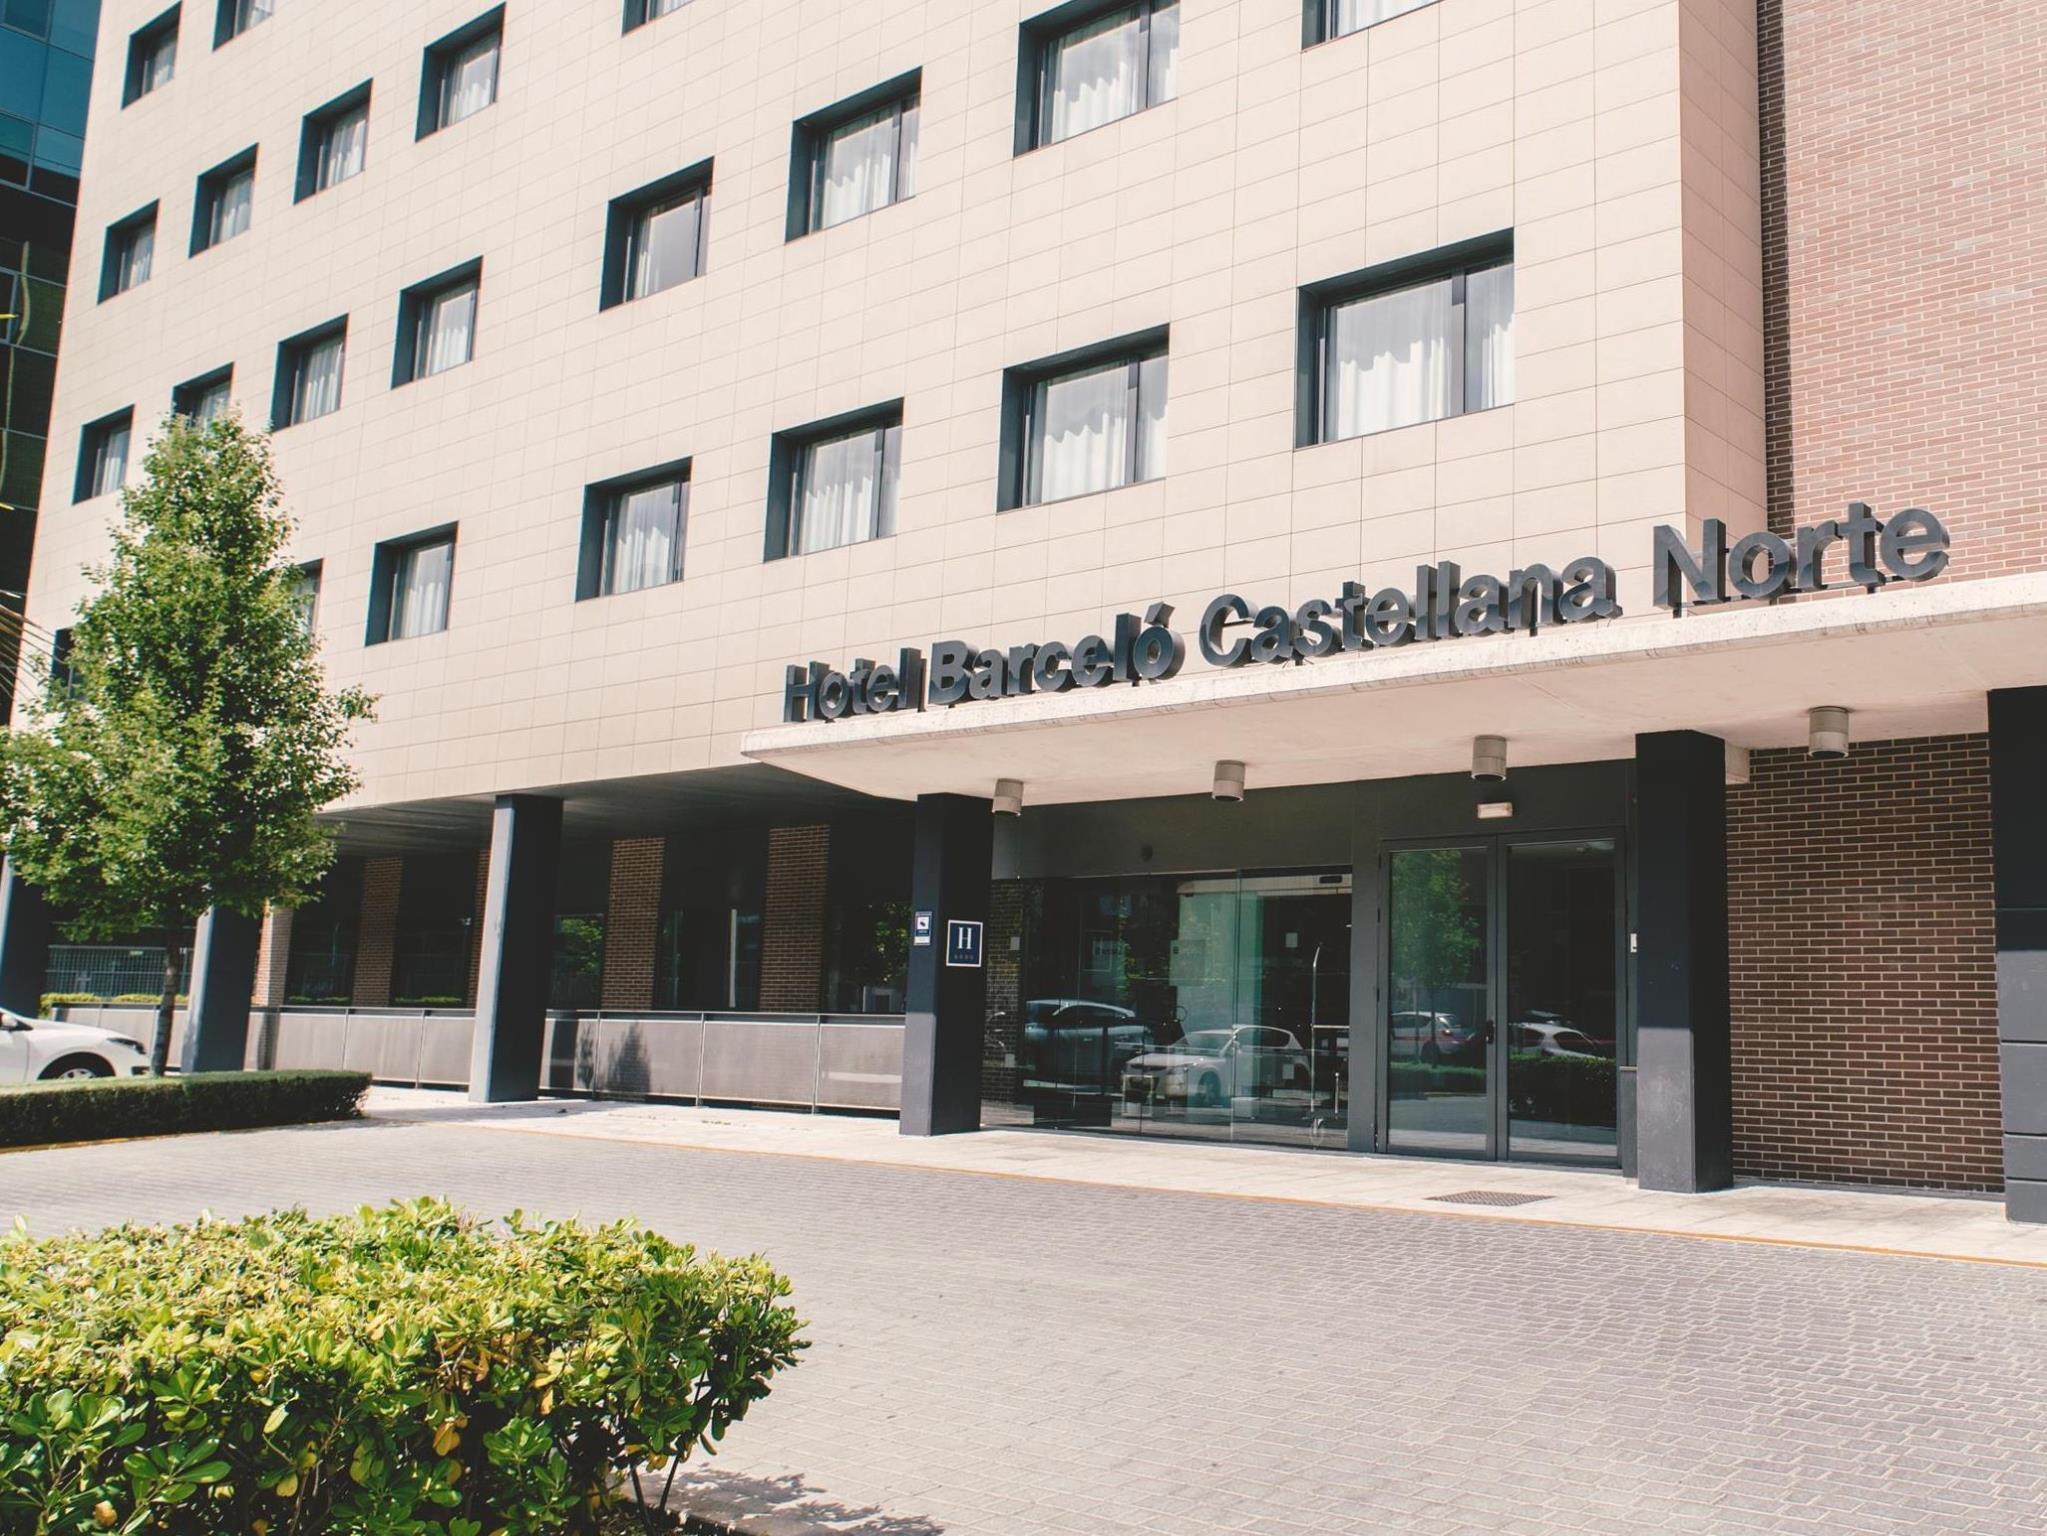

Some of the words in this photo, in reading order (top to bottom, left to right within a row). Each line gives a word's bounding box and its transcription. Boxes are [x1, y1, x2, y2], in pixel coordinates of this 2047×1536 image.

[783, 647, 927, 722] Hotel
[928, 602, 1186, 706] Barceló
[1199, 556, 1623, 667] Castellana
[1653, 502, 1951, 614] Norte
[957, 926, 973, 950] H
